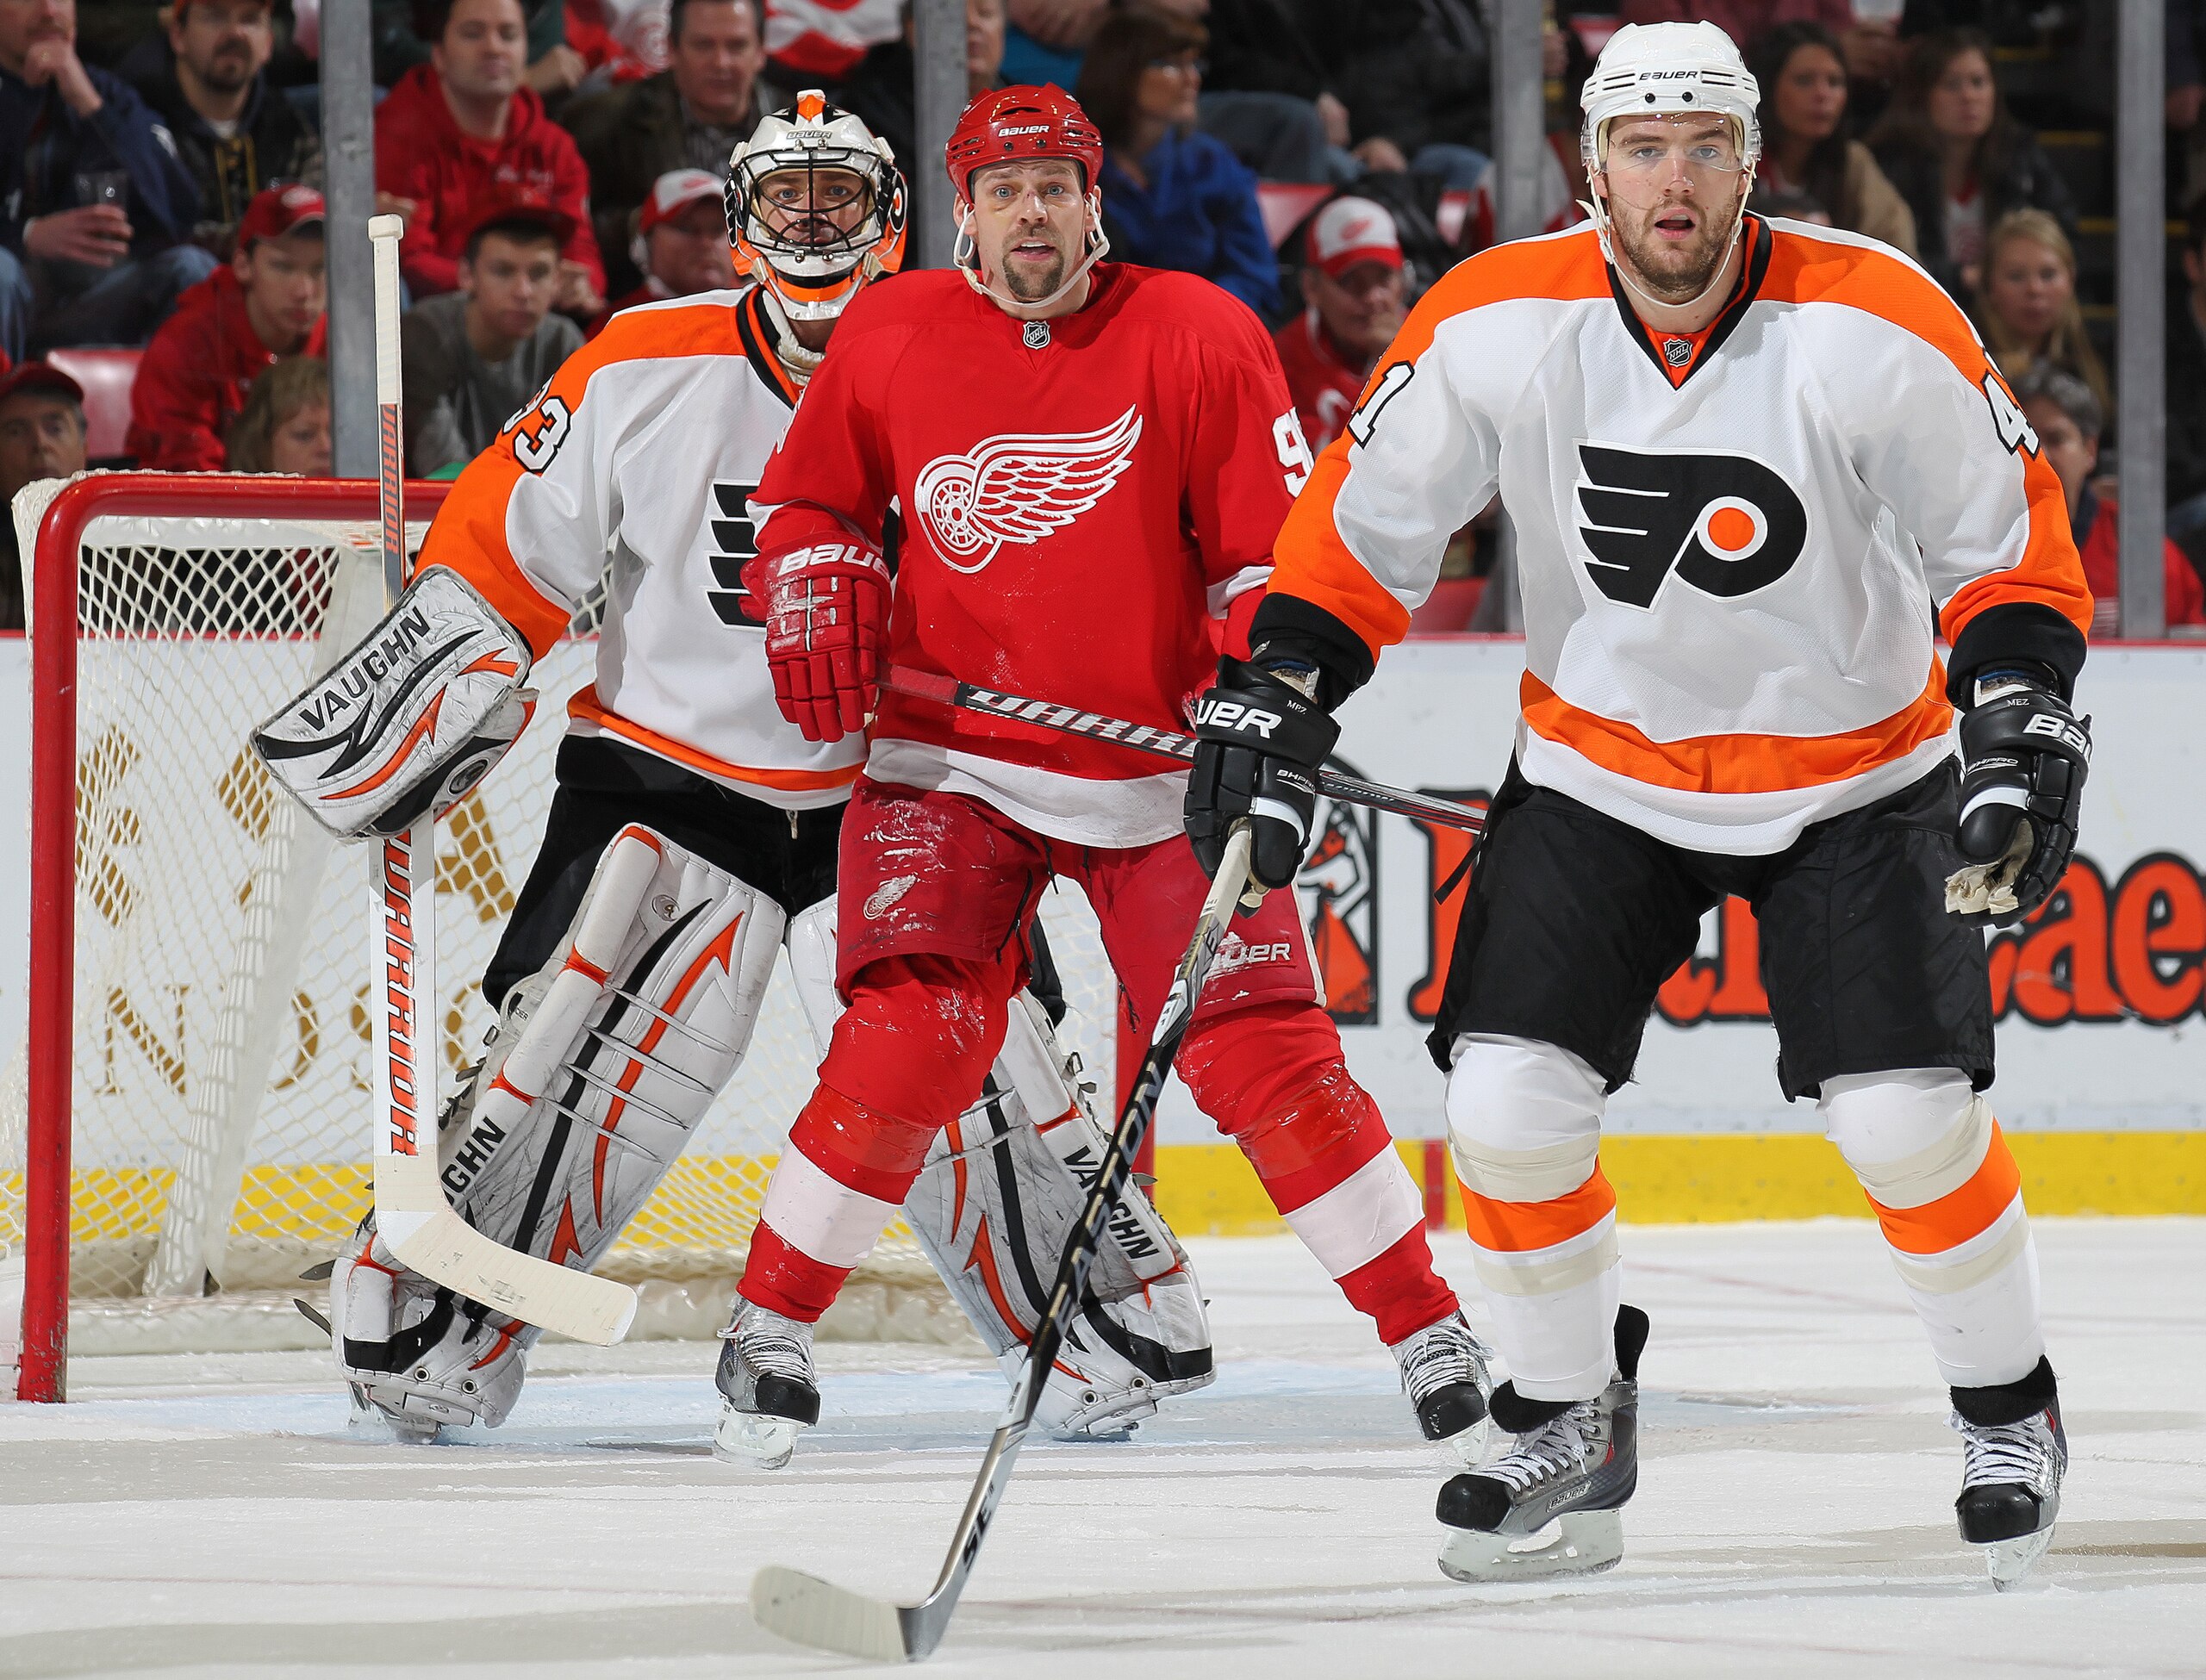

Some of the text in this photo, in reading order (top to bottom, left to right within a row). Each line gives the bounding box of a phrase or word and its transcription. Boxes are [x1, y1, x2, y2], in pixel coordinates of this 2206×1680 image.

[1637, 71, 1698, 81] BAUER
[786, 130, 832, 140] BAUER
[998, 125, 1050, 137] BAUER
[1347, 355, 1415, 450] 1
[1980, 350, 2041, 461] 4
[381, 403, 400, 555] WARRIOR
[1272, 406, 1316, 498] 9
[298, 605, 431, 731] VAUGHN
[2007, 698, 2029, 706] MEZ
[382, 829, 420, 1157] WARRIOR
